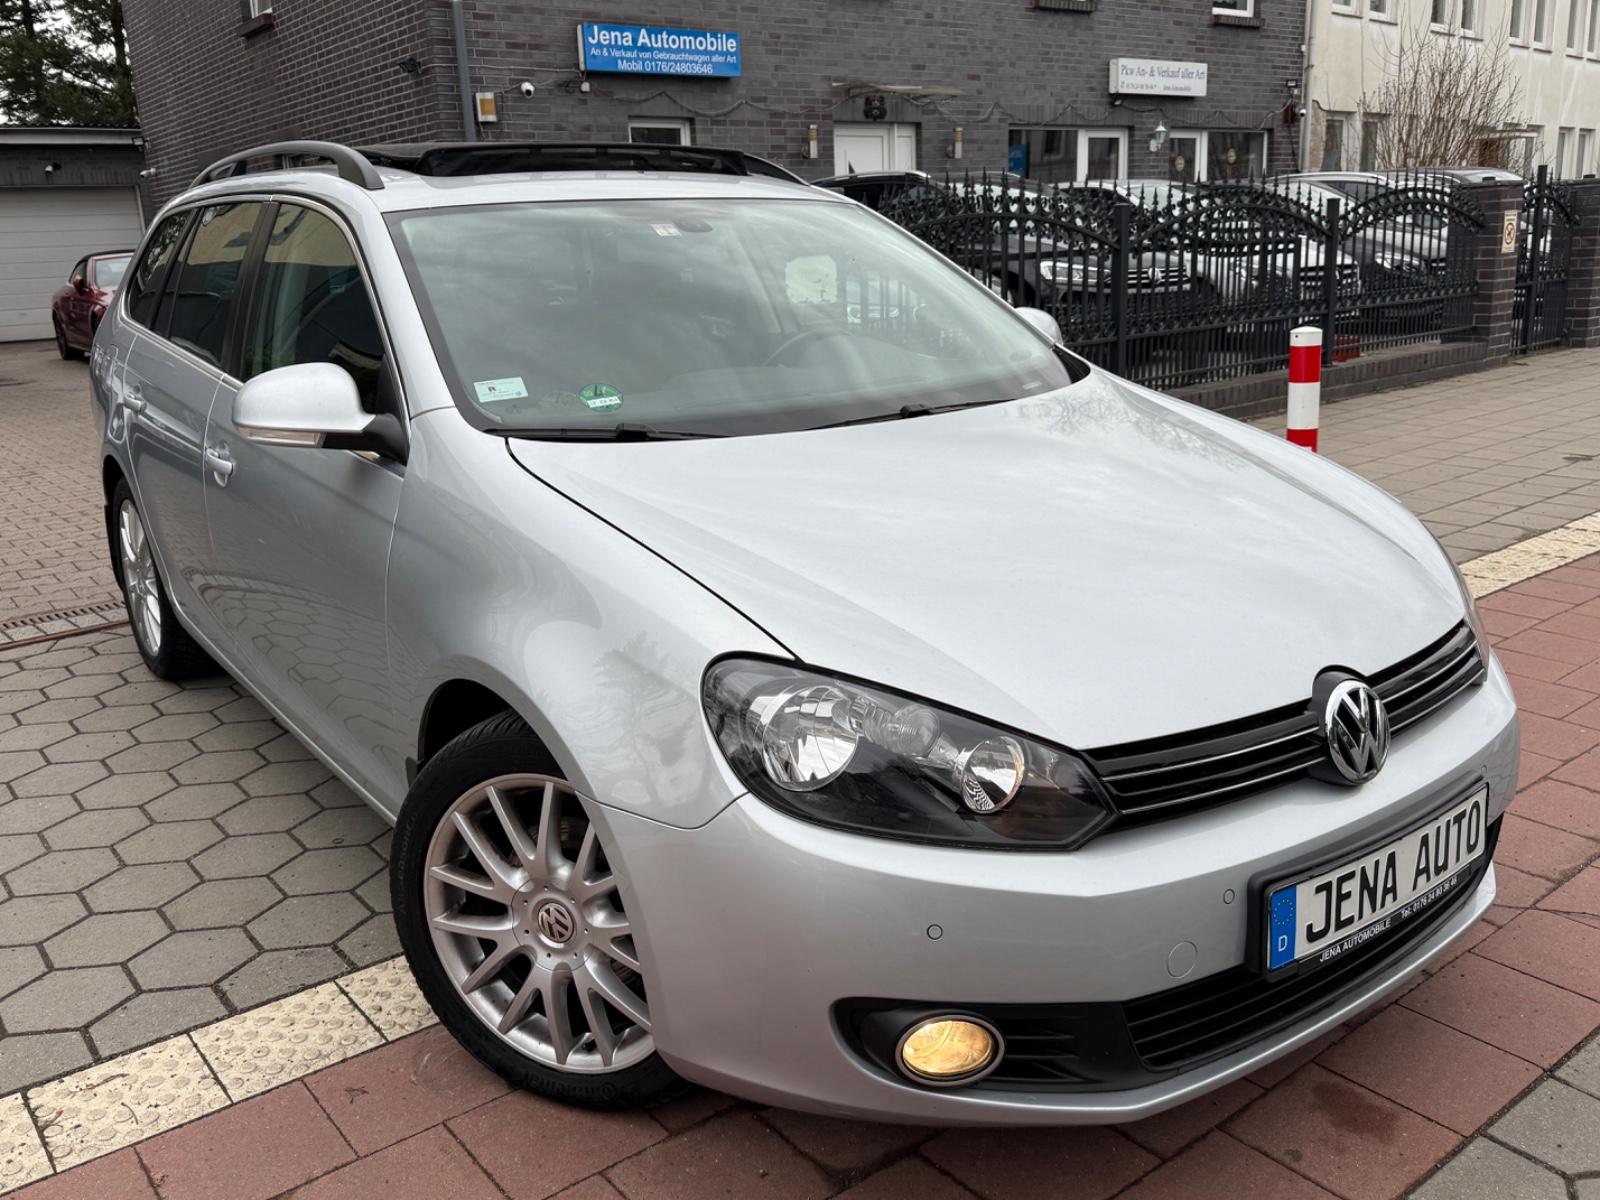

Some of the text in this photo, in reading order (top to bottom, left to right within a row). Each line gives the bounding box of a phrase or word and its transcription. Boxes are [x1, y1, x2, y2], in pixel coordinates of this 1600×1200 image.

[588, 25, 737, 52] Jena Automobile
[590, 48, 601, 56] An
[609, 48, 637, 58] Verkauf
[653, 50, 710, 63] Gebrauchtwagen
[711, 54, 726, 63] aller
[726, 55, 737, 63] Art
[617, 60, 713, 74] Mobil 0176/24803646
[1148, 66, 1155, 77] &
[1156, 66, 1181, 78] Verkauf
[1181, 68, 1194, 79] aller
[1326, 680, 1391, 784] VW
[1306, 800, 1481, 943] JENA AUTO
[1278, 935, 1288, 952] D
[1319, 918, 1392, 963] JENA AUTOMOBILE
